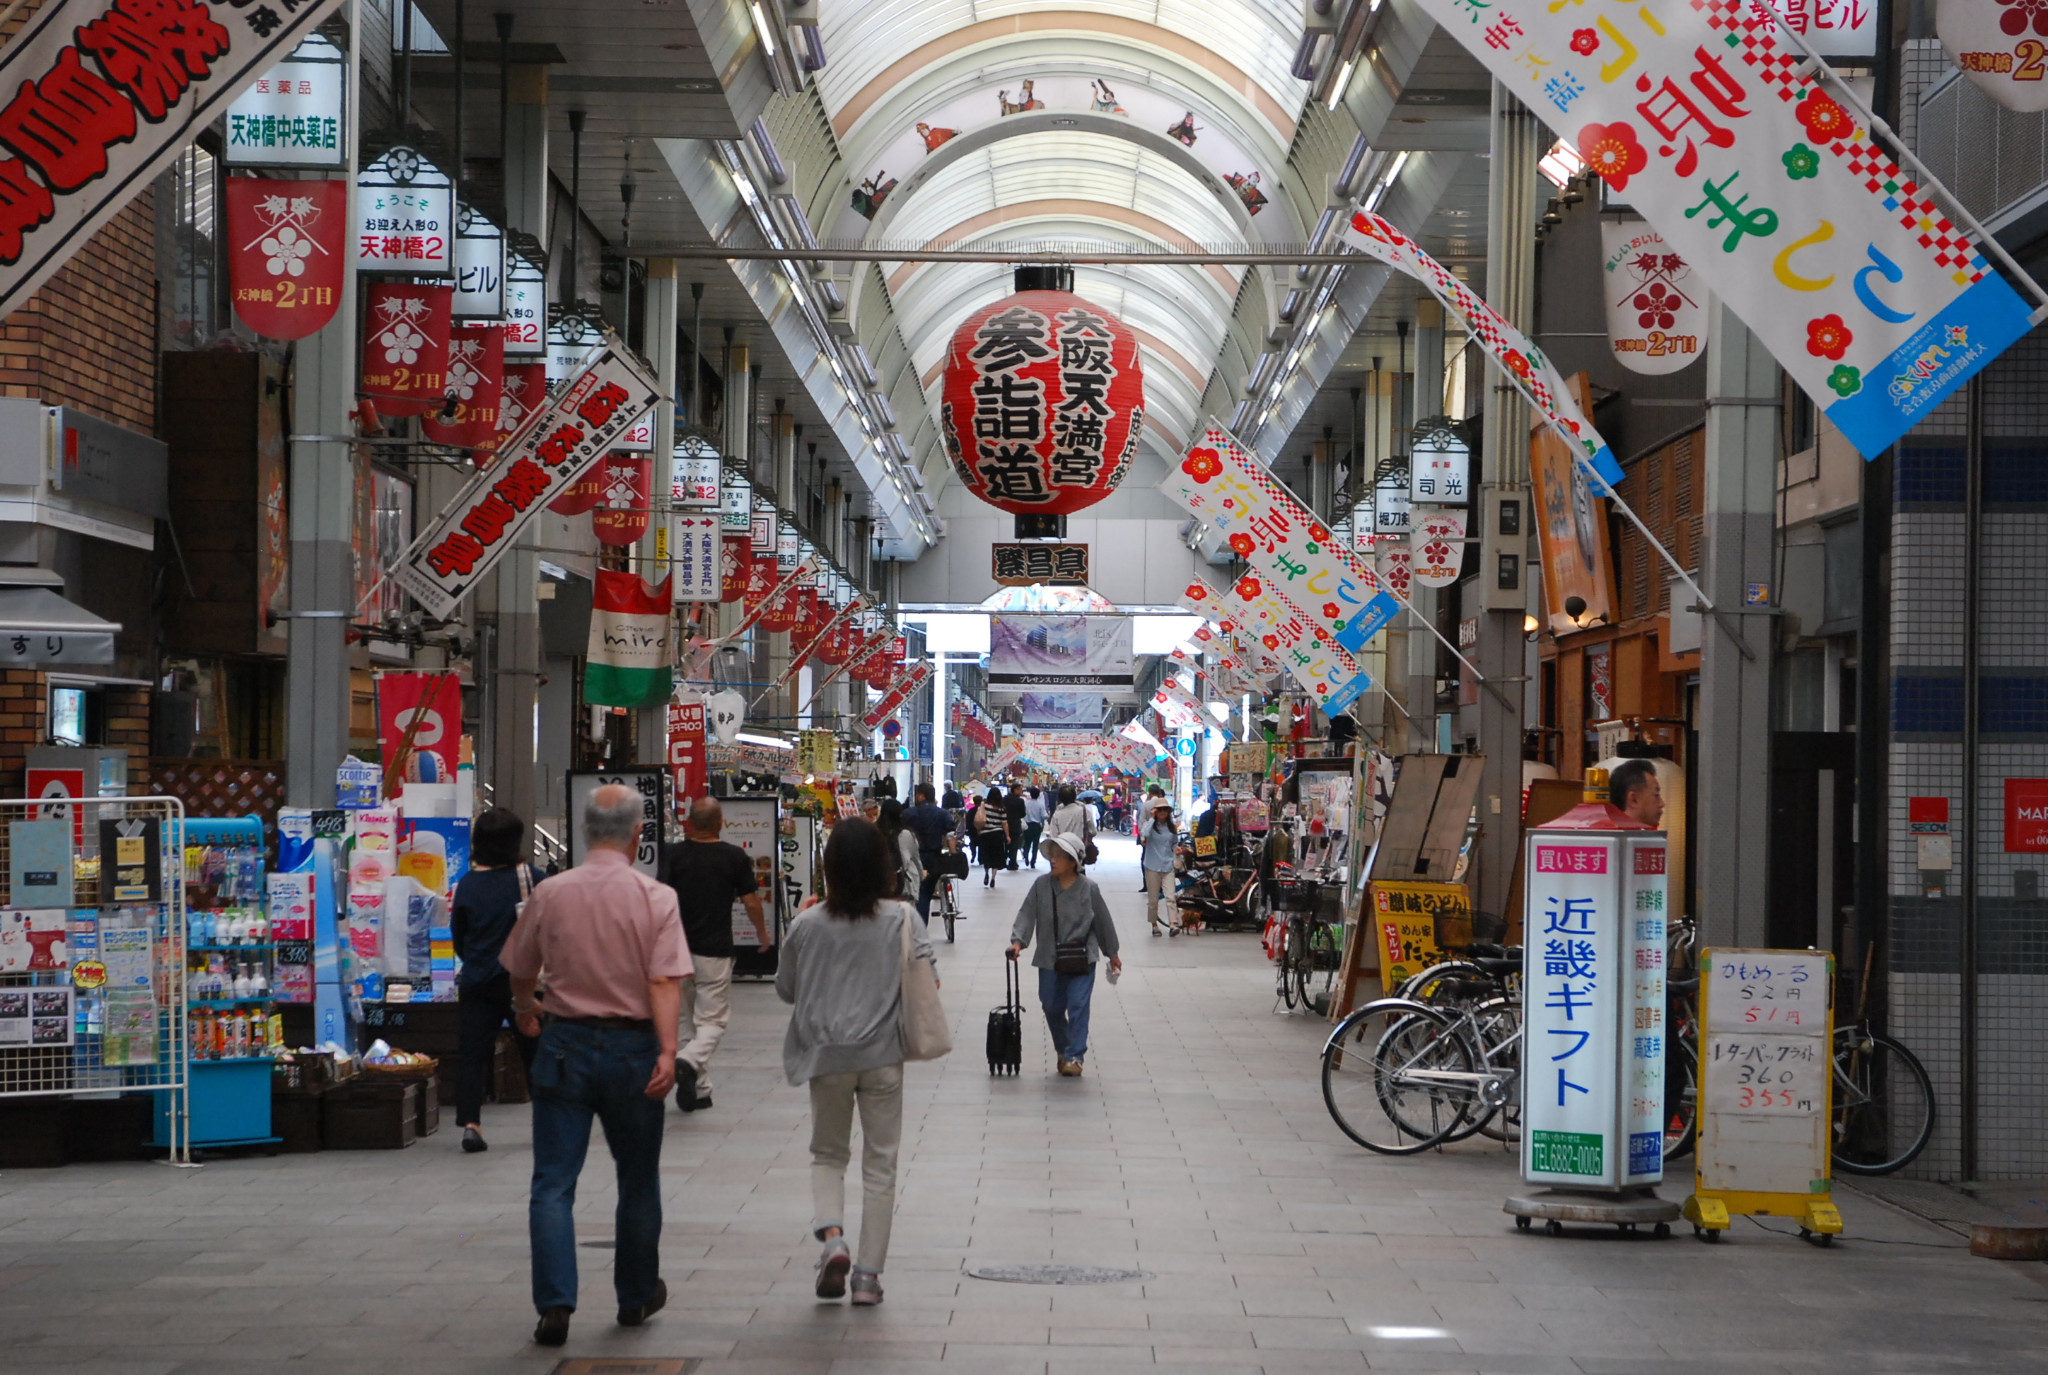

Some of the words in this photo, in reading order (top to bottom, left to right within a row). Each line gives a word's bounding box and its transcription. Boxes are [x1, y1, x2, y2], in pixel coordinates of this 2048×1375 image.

[1961, 40, 2048, 81] 天神橋2
[256, 79, 312, 95] 医薬品
[231, 114, 337, 149] 天神橋中央薬店
[375, 194, 429, 211] ようこそ
[365, 218, 438, 231] お迎え人形の
[360, 236, 443, 260] 天神橋2
[236, 281, 332, 309] 天神橋2丁目
[1614, 331, 1697, 357] 天神橋2丁目
[363, 368, 440, 391] 天神橋2丁目
[1053, 312, 1115, 485] 大阪天満宮
[423, 404, 494, 424] 天神2丁目
[557, 404, 638, 478] 上方落語の定席
[672, 485, 716, 499] 天橋2
[701, 532, 712, 586] 大阪天満宮北門
[995, 547, 1088, 578] 繁昌亭
[10, 634, 64, 657] すり
[316, 816, 343, 832] 498
[1911, 823, 1947, 833] SECOM
[1539, 849, 1607, 872] 買います
[1401, 924, 1433, 938] めん家
[1385, 925, 1399, 961] セルフ
[1721, 962, 1810, 983] かもめーる
[1543, 896, 1598, 1107] 近畿ギフト
[1737, 1064, 1795, 1085] 360
